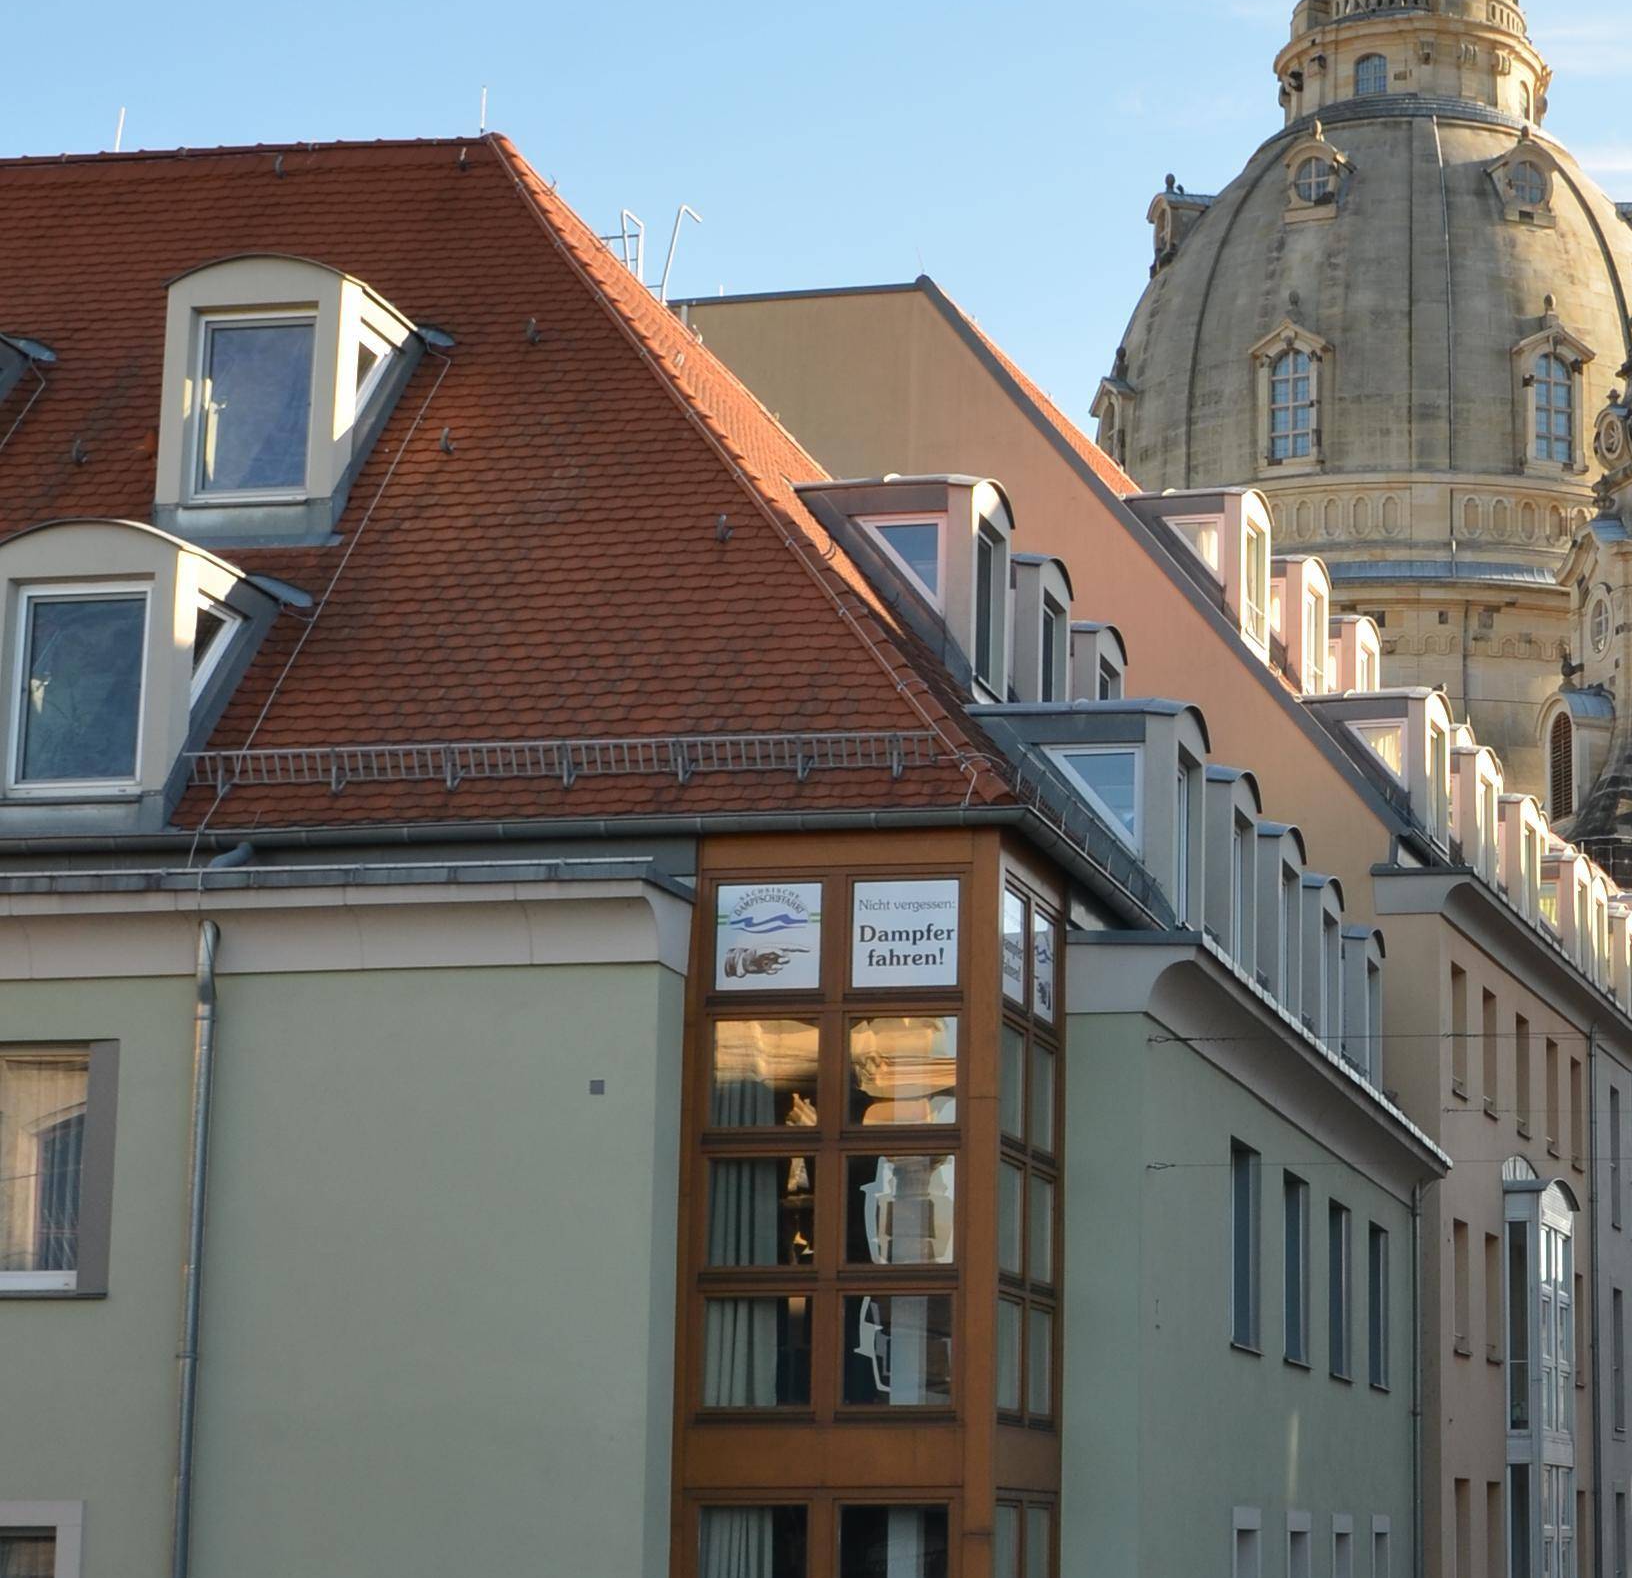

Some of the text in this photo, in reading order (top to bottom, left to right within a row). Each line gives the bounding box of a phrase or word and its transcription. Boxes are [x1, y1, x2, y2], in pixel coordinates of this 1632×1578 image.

[858, 898, 955, 913] Nicht vergessen:
[859, 922, 955, 946] Dampfer
[867, 947, 944, 967] fahren!
